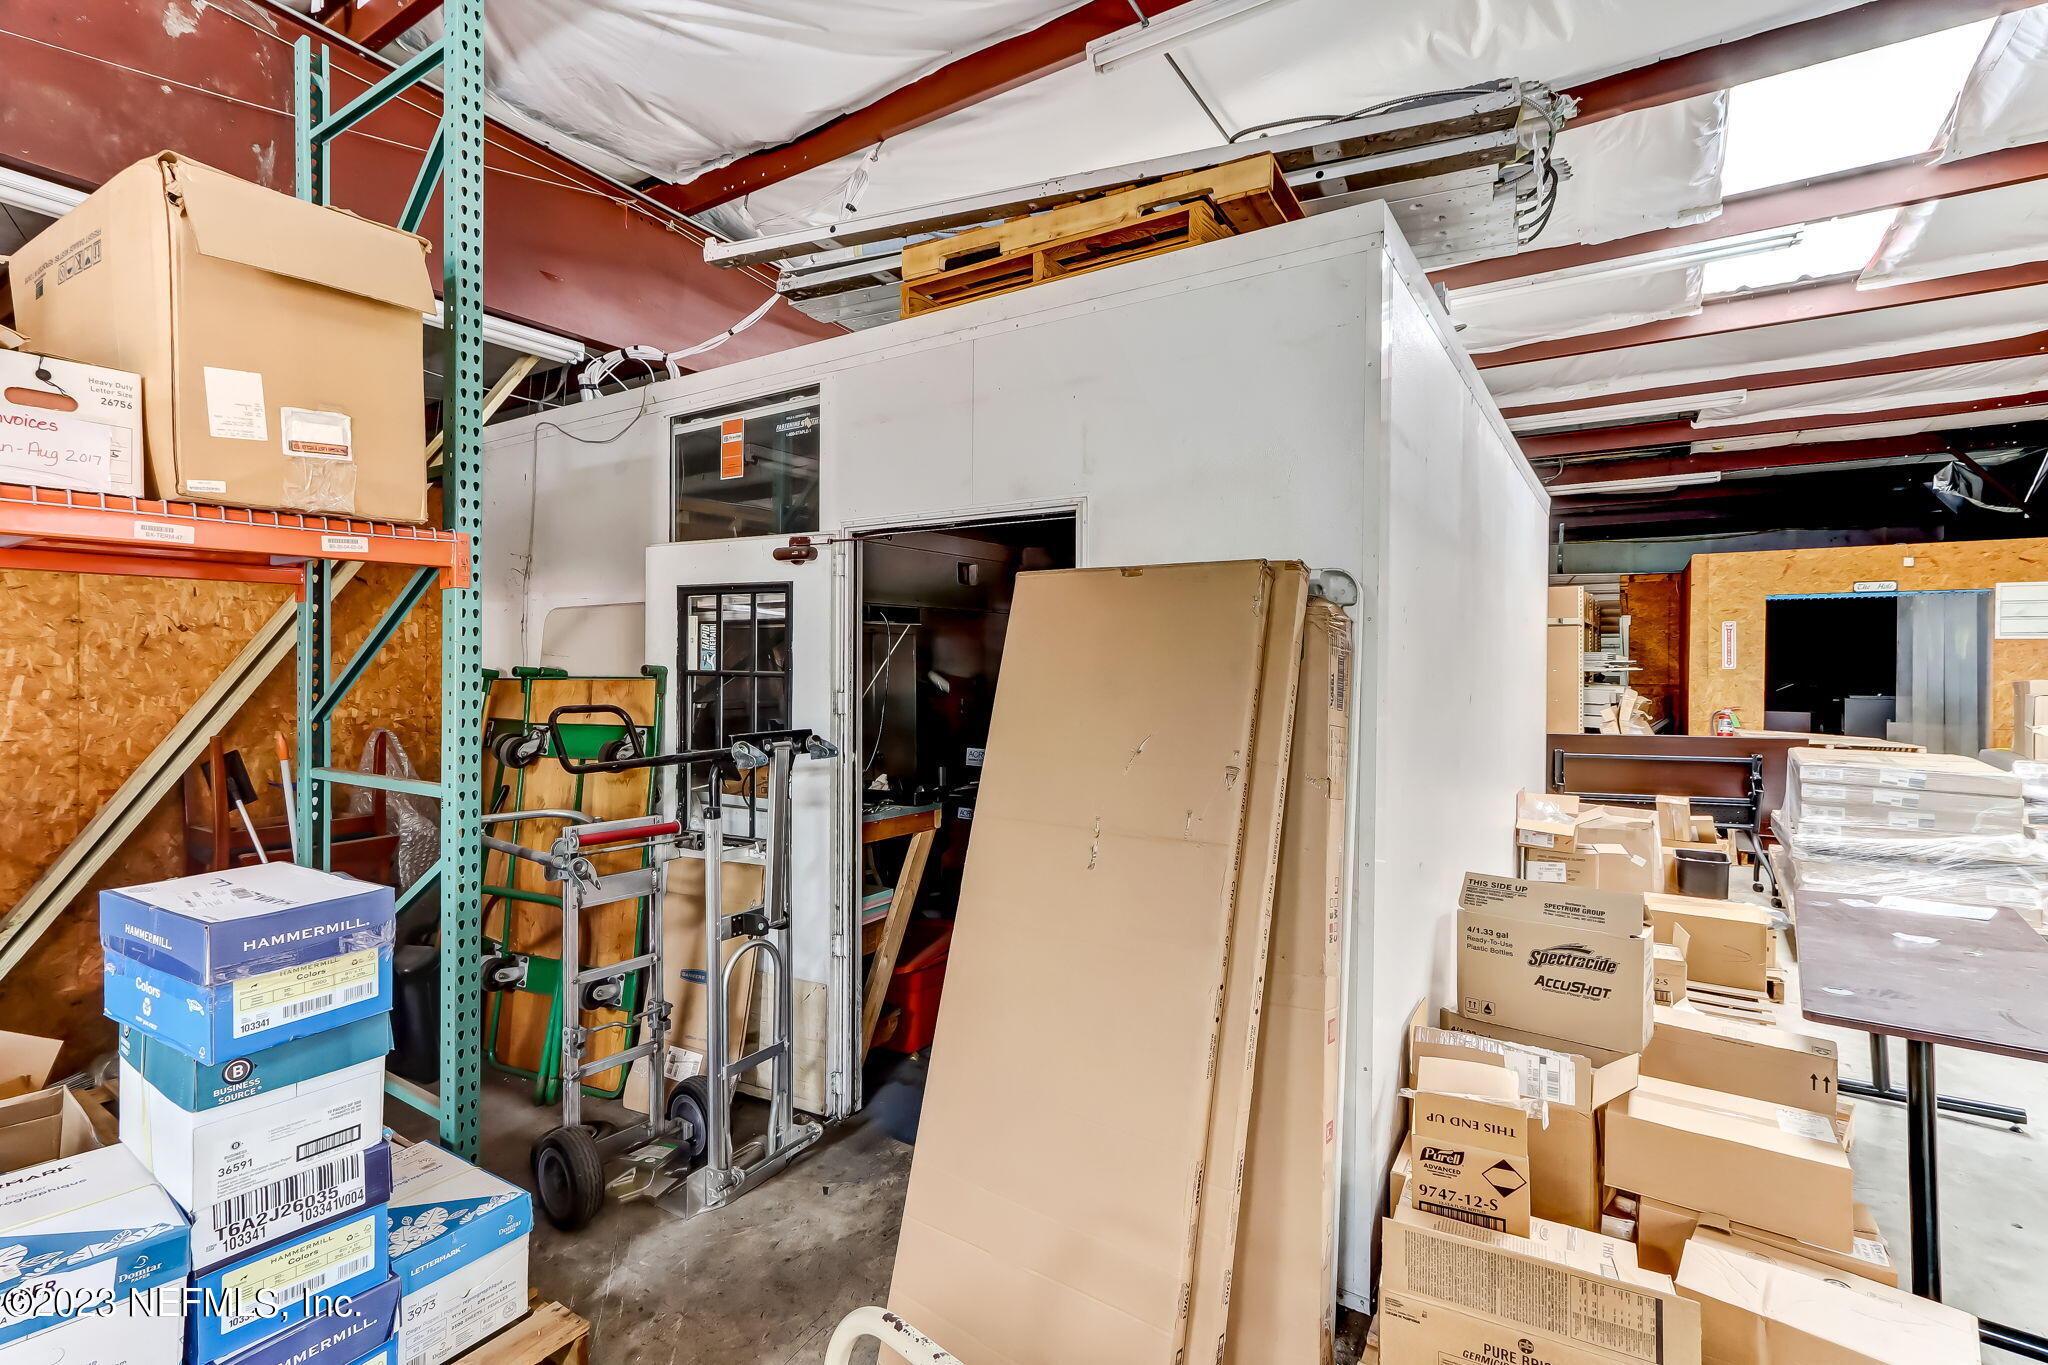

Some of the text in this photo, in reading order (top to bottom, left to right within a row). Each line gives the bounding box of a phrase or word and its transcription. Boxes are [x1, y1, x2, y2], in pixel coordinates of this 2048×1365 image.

[88, 378, 134, 391] Heavy Duty
[90, 386, 133, 398] Letter Size
[100, 398, 132, 410] 26756
[65, 450, 102, 466] 2017
[1468, 878, 1488, 888] THIS
[1491, 882, 1512, 890] SIDE
[1544, 902, 1580, 913] SPECTRUM
[1582, 908, 1606, 916] GROUP
[1466, 926, 1494, 936] 4/1.33
[1466, 934, 1514, 948] Ready-To-Use
[1466, 943, 1514, 957] Plastic Bottles
[280, 958, 339, 977] HAMMERMILL
[1528, 949, 1617, 974] Spectracide
[296, 969, 326, 981] Colors
[135, 977, 160, 998] Colors
[240, 1018, 270, 1033] 103341
[233, 1064, 244, 1078] B
[213, 1078, 260, 1097] BUSINESS
[218, 1088, 256, 1105] SOURCE
[1426, 1113, 1516, 1138] THIS END UP
[218, 1158, 252, 1177] 36591
[1424, 1163, 1461, 1175] ADVANCED
[1419, 1184, 1498, 1211] 9747-12-S
[214, 1186, 339, 1241] T6A2J26035
[299, 1189, 364, 1223] 103341V004
[498, 1220, 522, 1235] Domtar
[223, 1226, 266, 1252] 103341
[270, 1237, 334, 1264] HAMMERMILL
[288, 1250, 319, 1265] Colors
[410, 1248, 461, 1276] LETTERMARK
[118, 1261, 162, 1284] Domtar
[131, 1274, 152, 1284] PAPER
[408, 1299, 436, 1321] 3973
[1484, 1343, 1517, 1364] PURE
